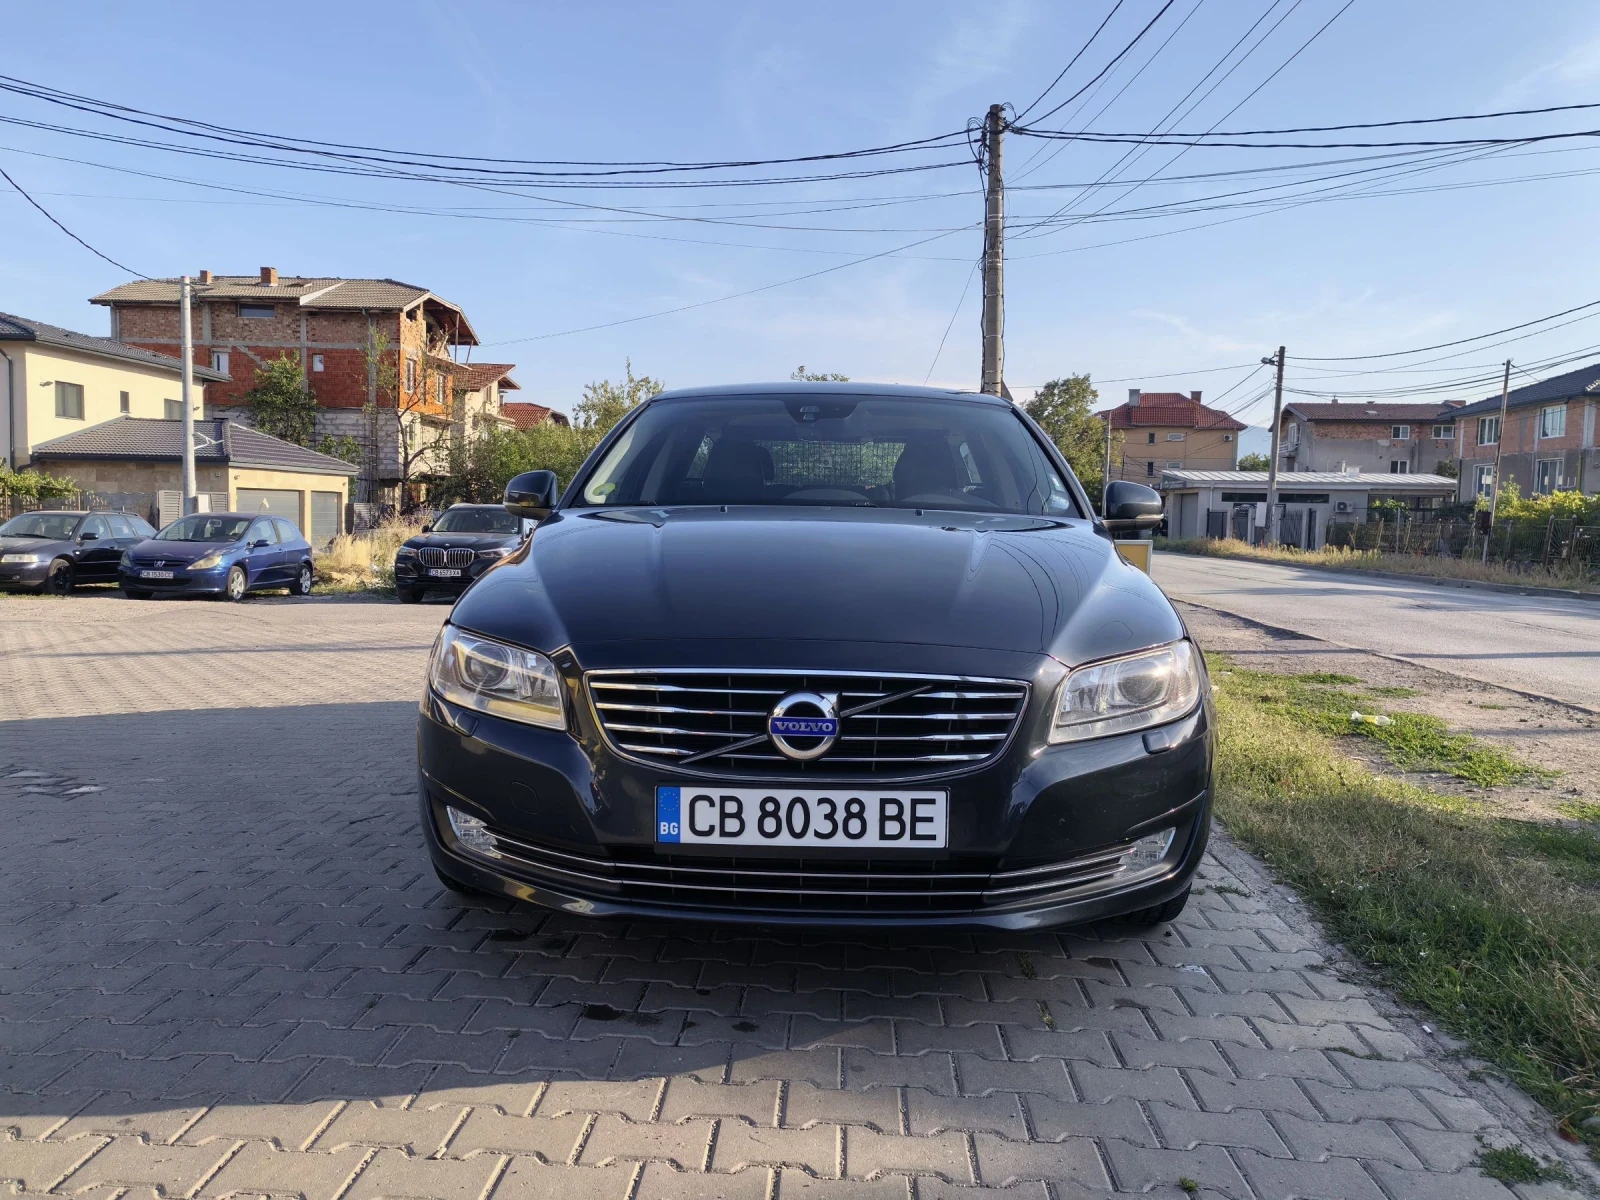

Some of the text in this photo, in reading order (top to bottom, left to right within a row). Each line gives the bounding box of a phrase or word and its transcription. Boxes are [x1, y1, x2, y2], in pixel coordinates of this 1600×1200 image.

[774, 720, 834, 733] VOLVO
[688, 794, 937, 841] CB 8038 BE
[660, 821, 679, 835] BG
